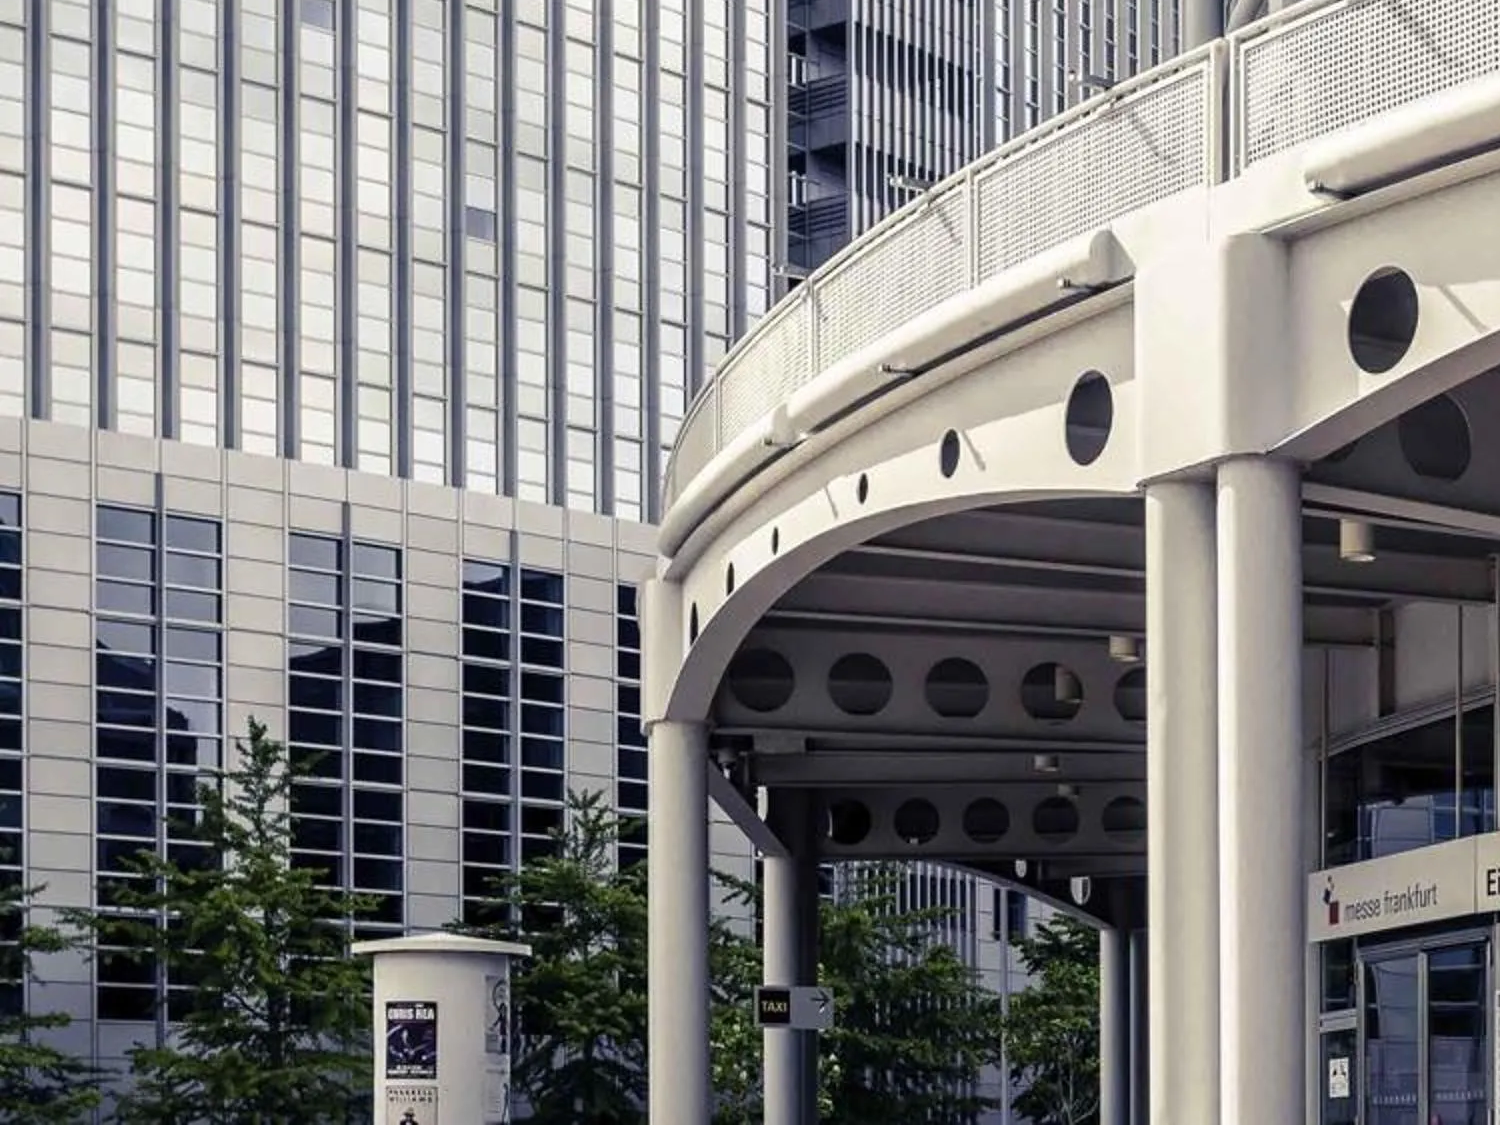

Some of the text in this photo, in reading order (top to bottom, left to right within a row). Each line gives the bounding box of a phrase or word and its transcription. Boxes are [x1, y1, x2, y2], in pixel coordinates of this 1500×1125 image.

[1344, 881, 1438, 923] messe frankfurt
[762, 1000, 787, 1013] TAXI
